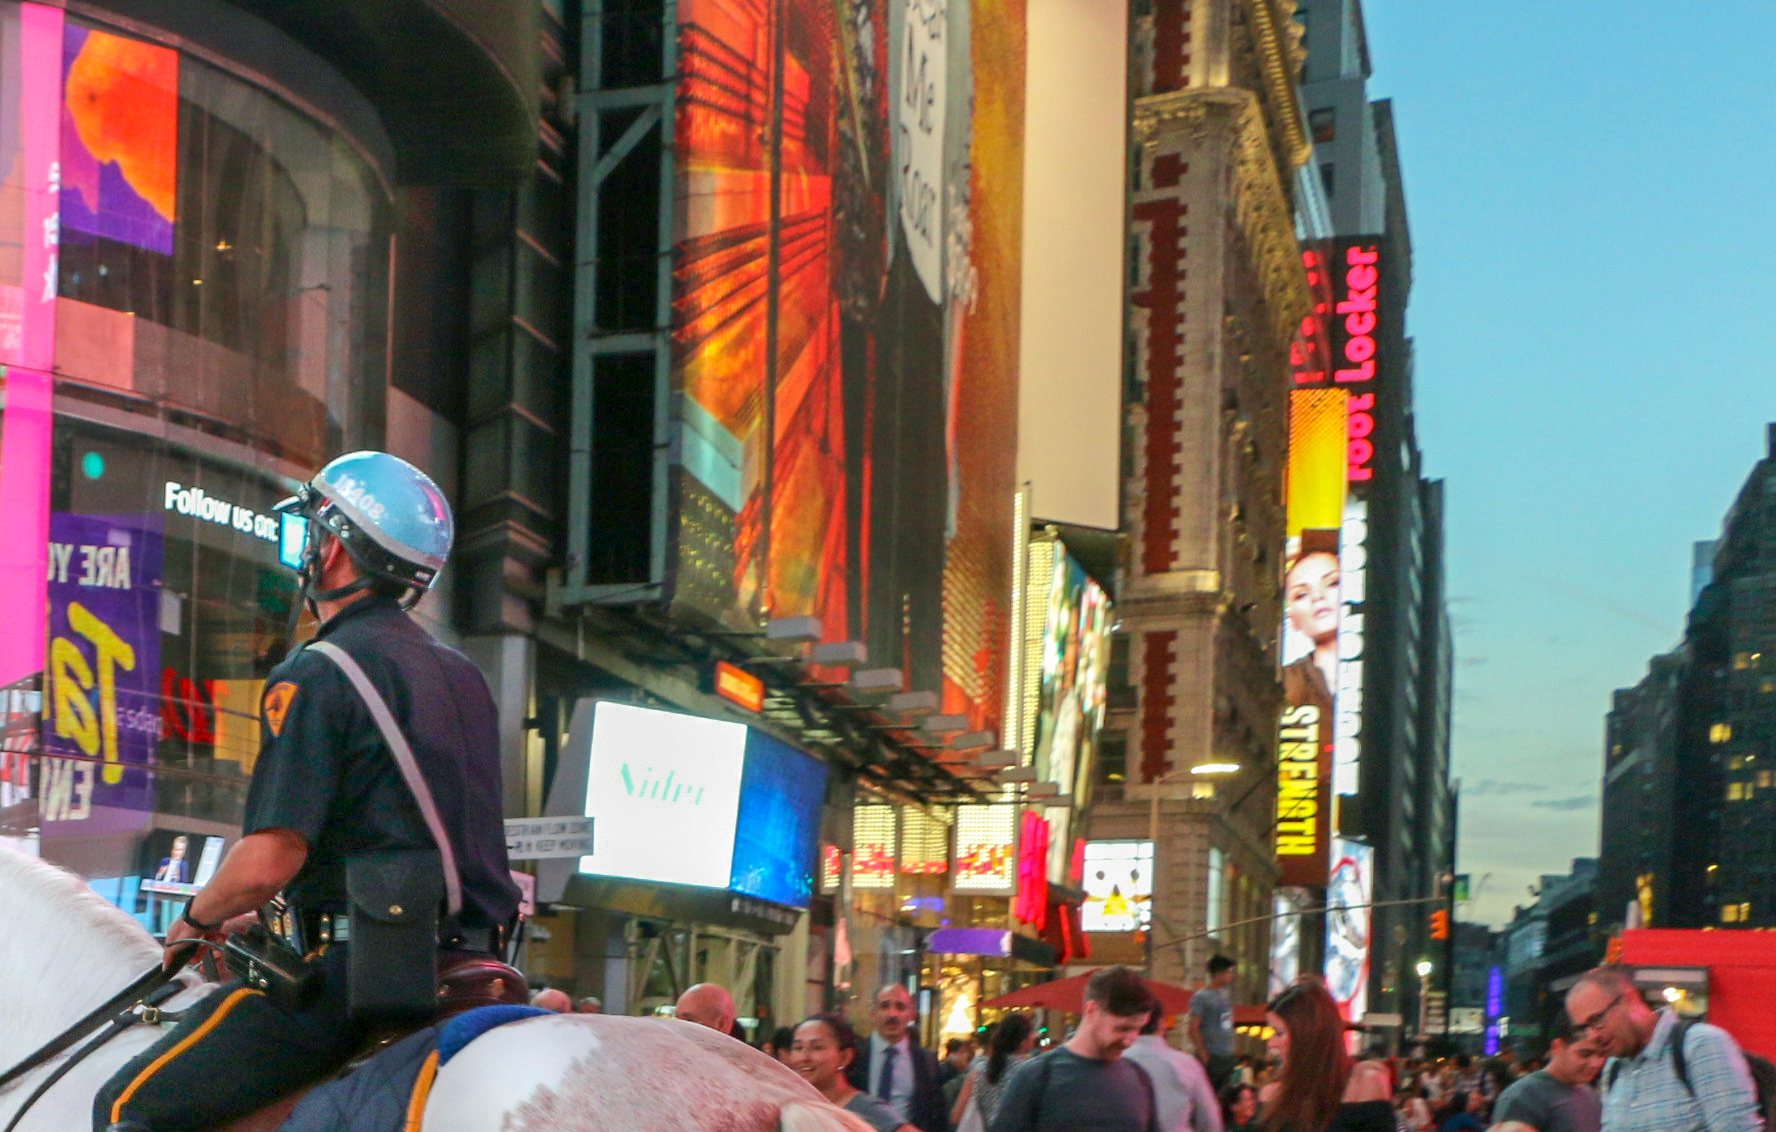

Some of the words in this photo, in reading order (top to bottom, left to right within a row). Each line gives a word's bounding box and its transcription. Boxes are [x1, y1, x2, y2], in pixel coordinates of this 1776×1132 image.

[1333, 246, 1379, 383] Locker
[164, 481, 230, 526] Follow
[232, 505, 254, 534] us
[254, 517, 281, 543] on:
[1276, 704, 1322, 856] STRENGTH
